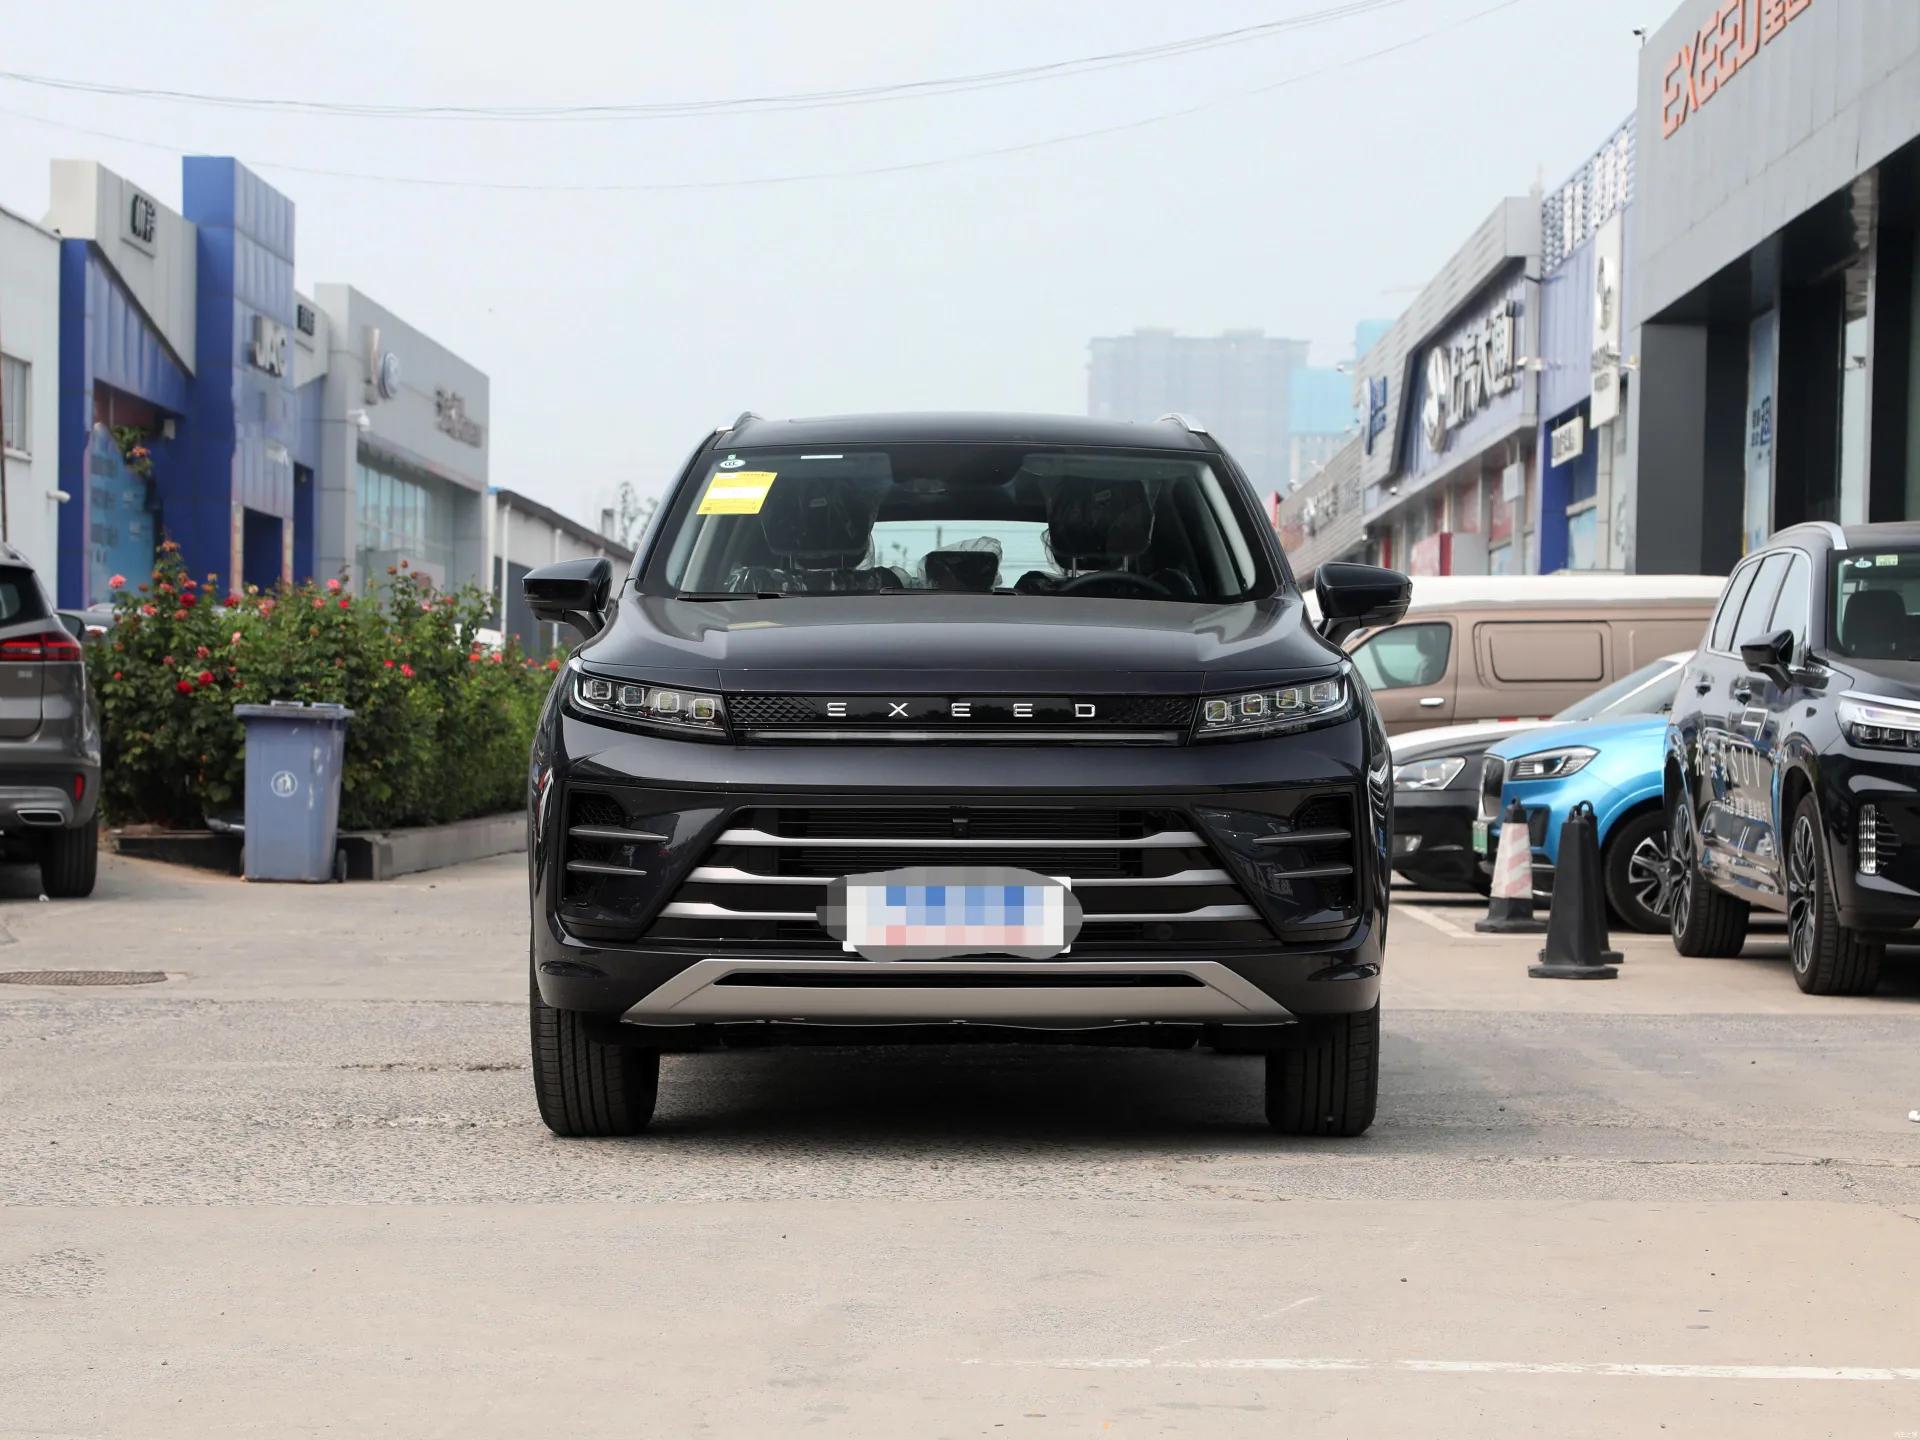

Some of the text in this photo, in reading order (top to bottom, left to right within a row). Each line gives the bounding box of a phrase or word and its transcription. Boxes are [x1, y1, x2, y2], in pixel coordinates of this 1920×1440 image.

[1663, 0, 1761, 139] EXEED
[253, 314, 287, 377] JAC
[827, 702, 1096, 718] EXEED
